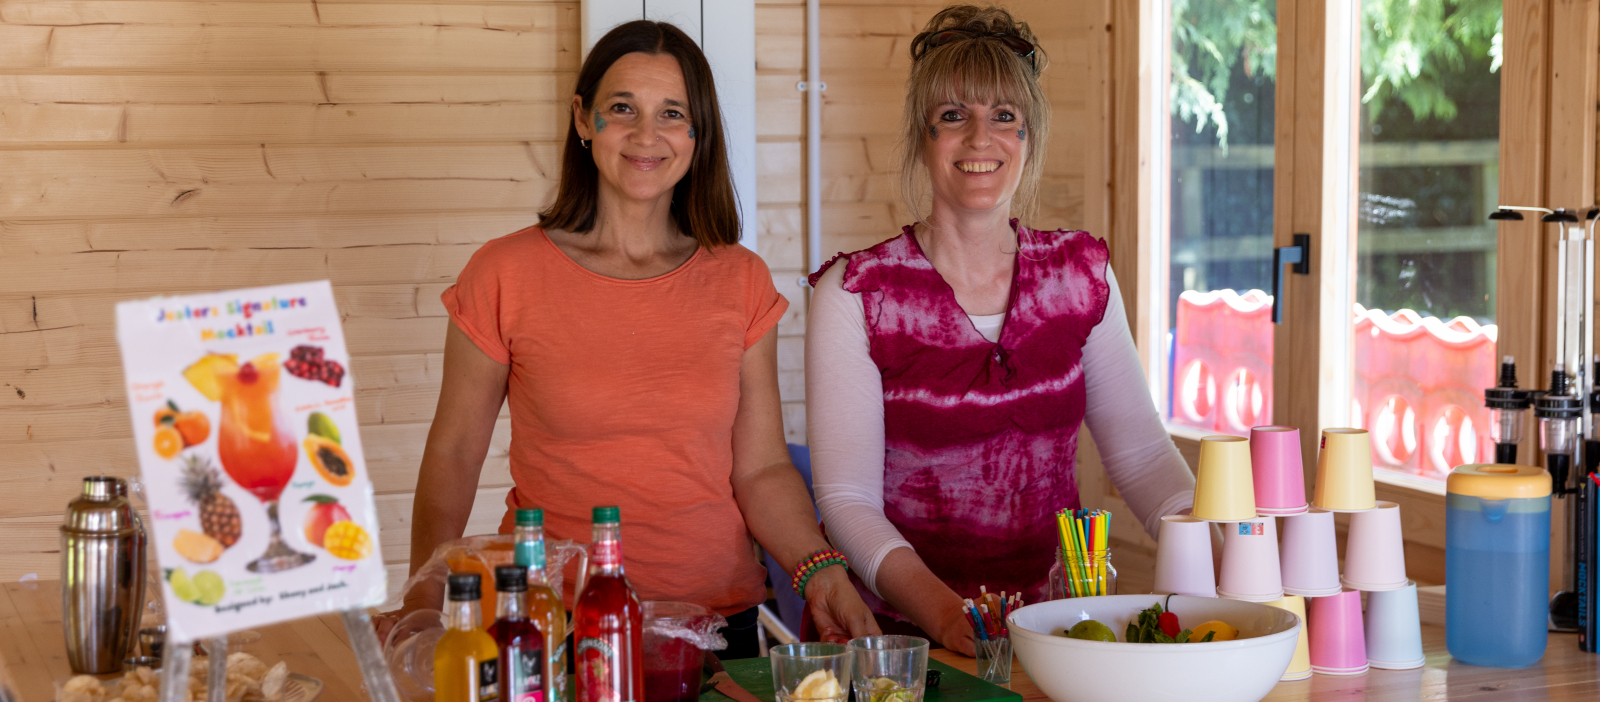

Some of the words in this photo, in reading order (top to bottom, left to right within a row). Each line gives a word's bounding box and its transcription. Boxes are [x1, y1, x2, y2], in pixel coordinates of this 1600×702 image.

[227, 297, 307, 319] Signature
[200, 320, 275, 342] Mocktail
[1578, 562, 1587, 627] MOCKTAILS
